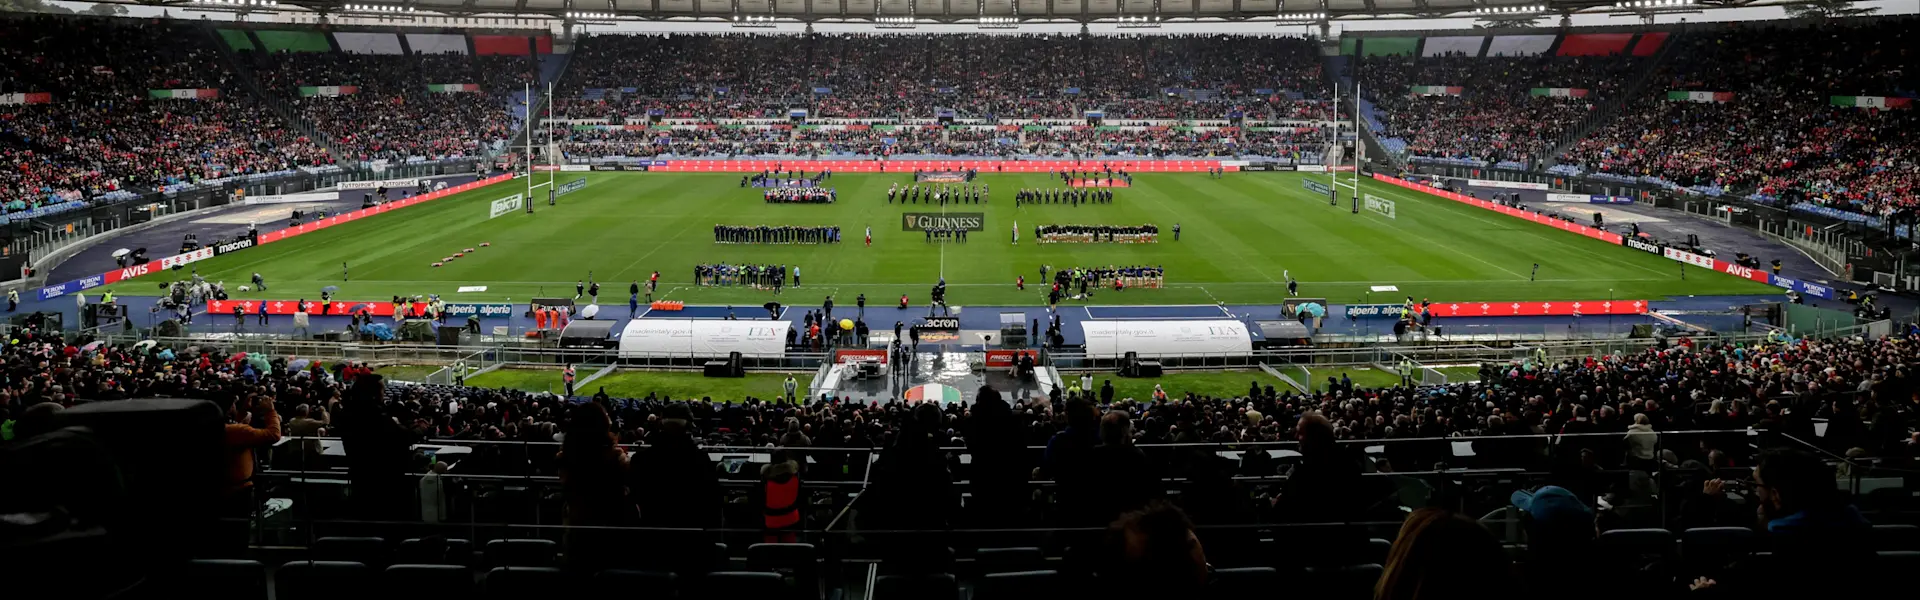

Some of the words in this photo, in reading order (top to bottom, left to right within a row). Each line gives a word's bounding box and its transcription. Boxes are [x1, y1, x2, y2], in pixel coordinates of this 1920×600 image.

[558, 183, 572, 195] IHG
[1303, 179, 1314, 189] IHG
[1368, 197, 1391, 214] BKT
[918, 215, 980, 229] GUINNESS
[219, 239, 252, 253] macron
[1628, 239, 1659, 254] macron
[121, 263, 149, 280] AVIS
[1726, 263, 1753, 279] AVIS
[80, 275, 101, 286] PERONI
[1773, 275, 1795, 286] PERONI
[43, 284, 66, 295] PERONI
[1803, 282, 1826, 293] PERONI
[446, 304, 477, 316] alperia
[480, 304, 511, 316] alperia
[1347, 305, 1378, 317] alperia
[1381, 305, 1403, 316] alpe
